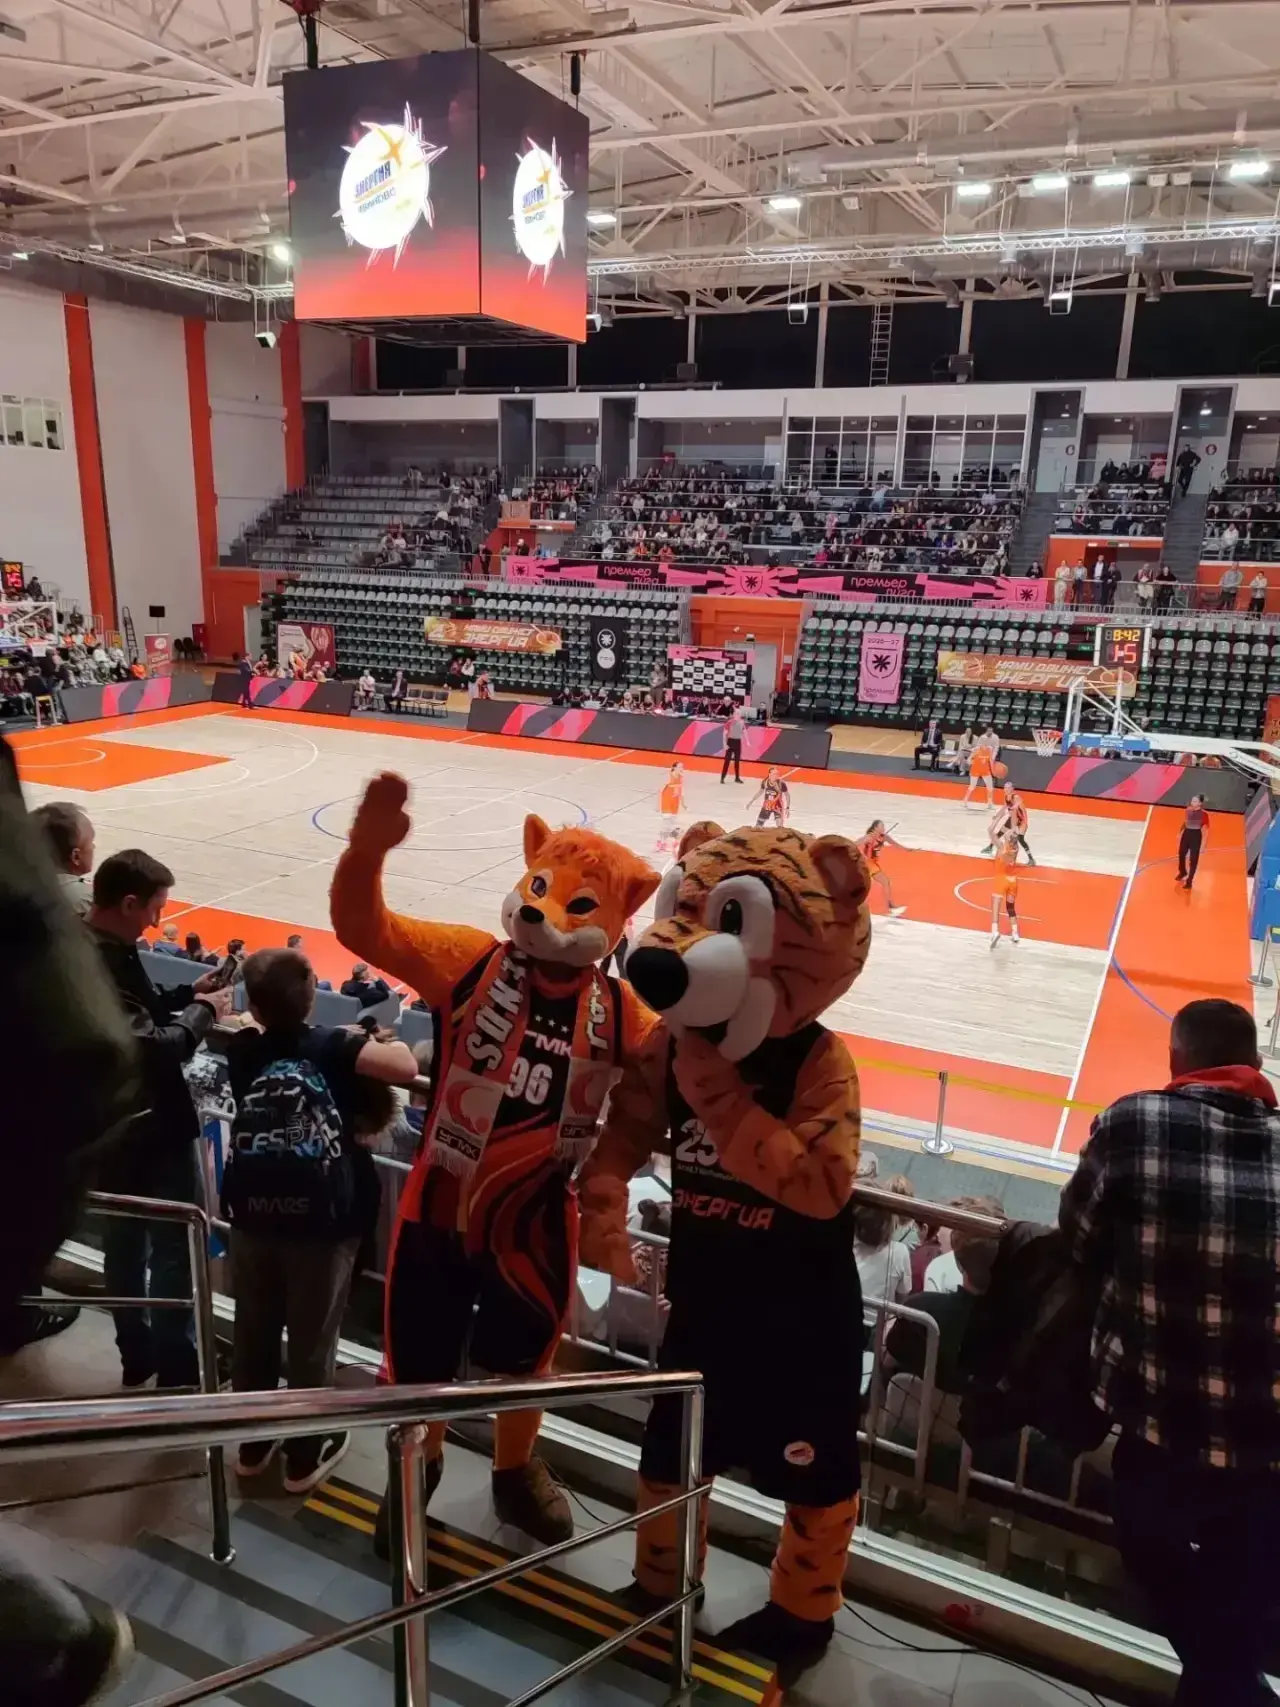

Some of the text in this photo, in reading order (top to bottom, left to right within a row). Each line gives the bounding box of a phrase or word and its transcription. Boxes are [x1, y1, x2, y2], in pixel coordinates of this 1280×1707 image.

[604, 566, 652, 577] премьер
[850, 576, 907, 589] премьер
[460, 633, 529, 647] ЭНЕРГИЯ
[995, 660, 1098, 675] НАМИ ДВИЖЕТ
[506, 1055, 553, 1106] 96
[437, 1128, 480, 1159] УГМК
[672, 1188, 775, 1230] ЭНЕРГИЯ
